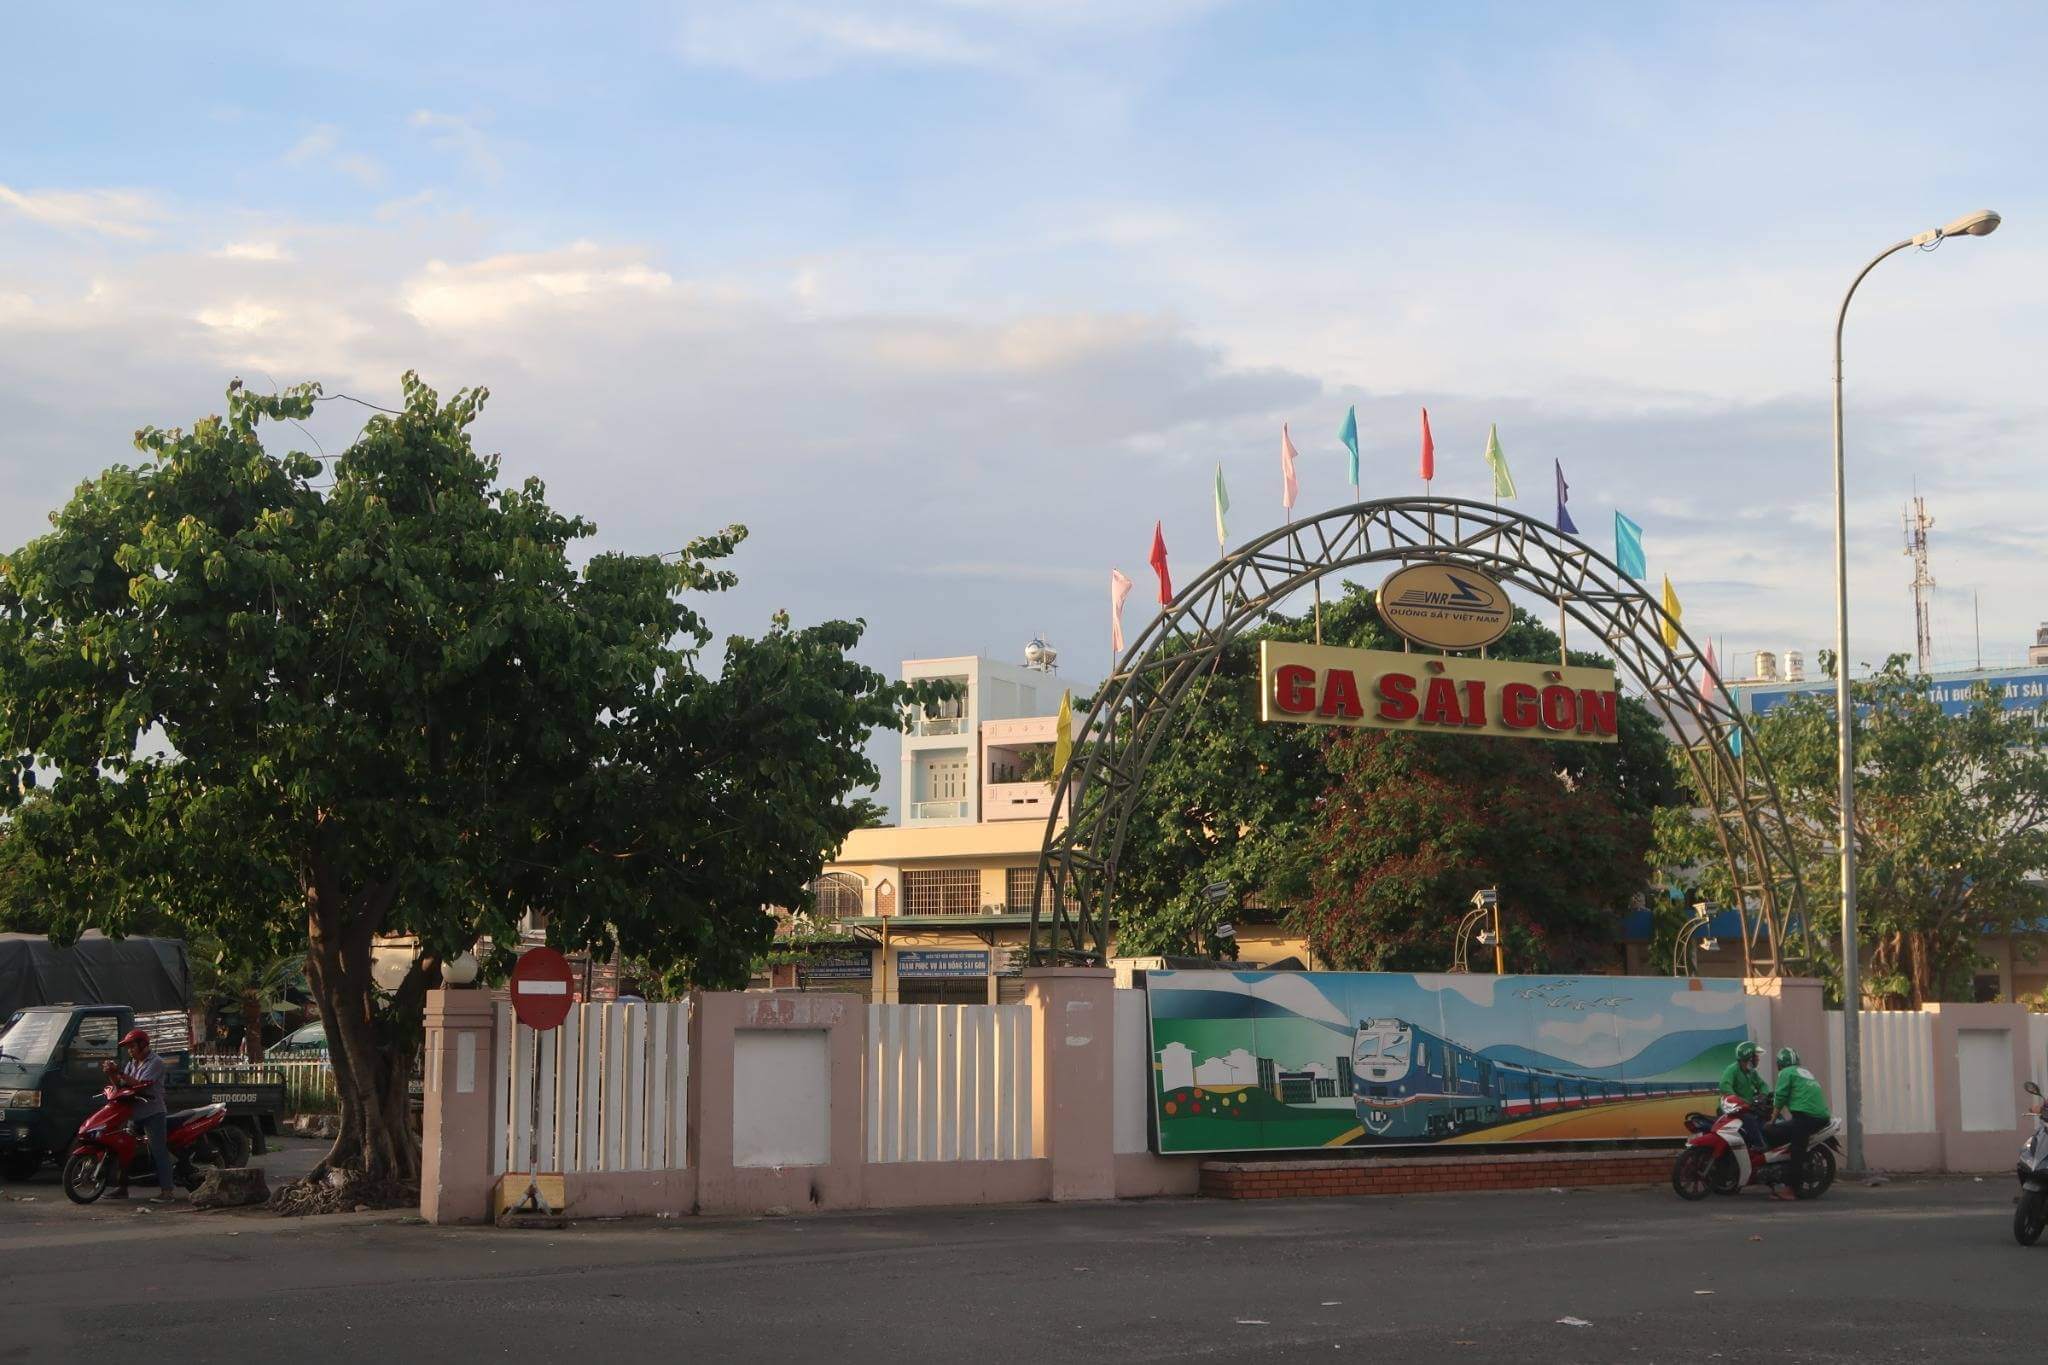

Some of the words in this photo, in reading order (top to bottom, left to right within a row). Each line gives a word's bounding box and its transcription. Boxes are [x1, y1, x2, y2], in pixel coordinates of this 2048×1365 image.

[1424, 591, 1449, 605] VNR
[1477, 615, 1500, 624] NAM
[2023, 680, 2043, 698] SÀI
[1274, 664, 1364, 719] GA
[1377, 660, 1488, 727] SÀI
[1501, 670, 1618, 736] GÒN
